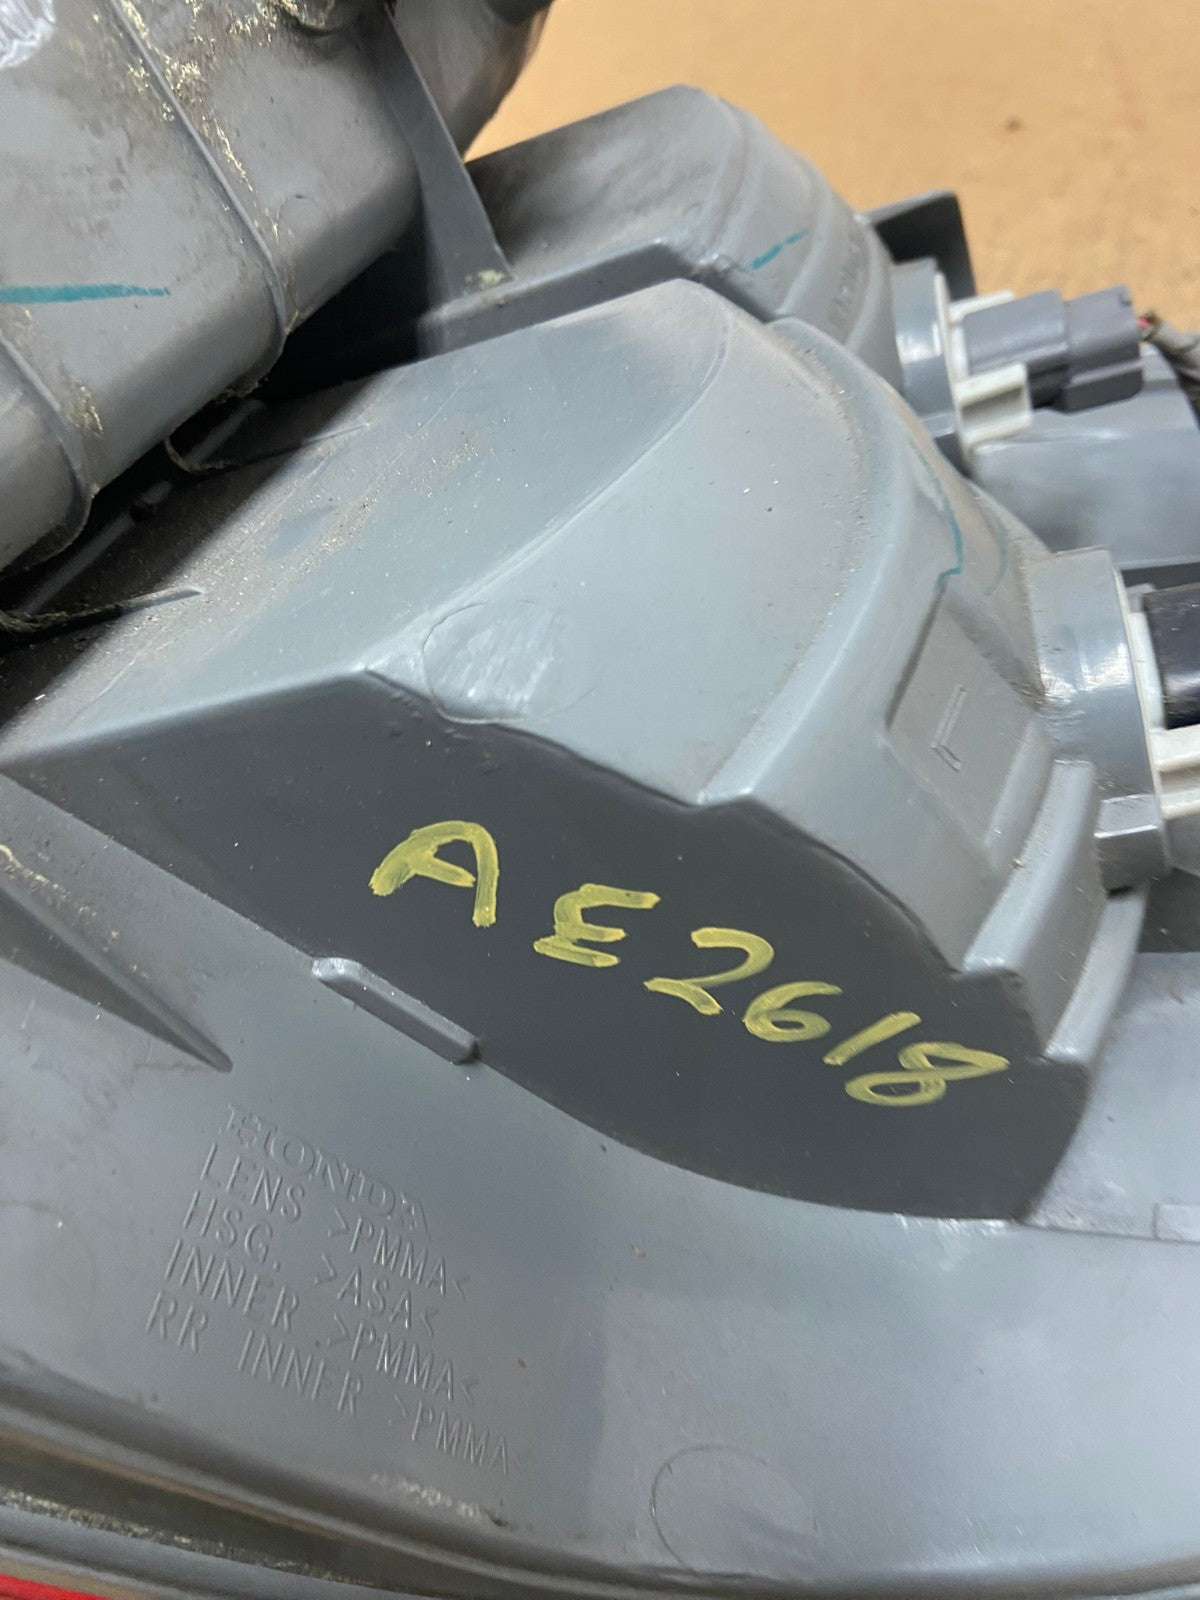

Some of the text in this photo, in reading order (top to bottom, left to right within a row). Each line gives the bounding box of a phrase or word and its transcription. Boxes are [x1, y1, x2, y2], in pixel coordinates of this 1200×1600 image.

[369, 819, 1010, 1107] AE2618
[200, 1141, 305, 1222] LENS
[182, 1189, 282, 1273] HSG.
[164, 1238, 299, 1333] INNER
[146, 1290, 208, 1353] RR
[237, 1329, 363, 1416] INNER
